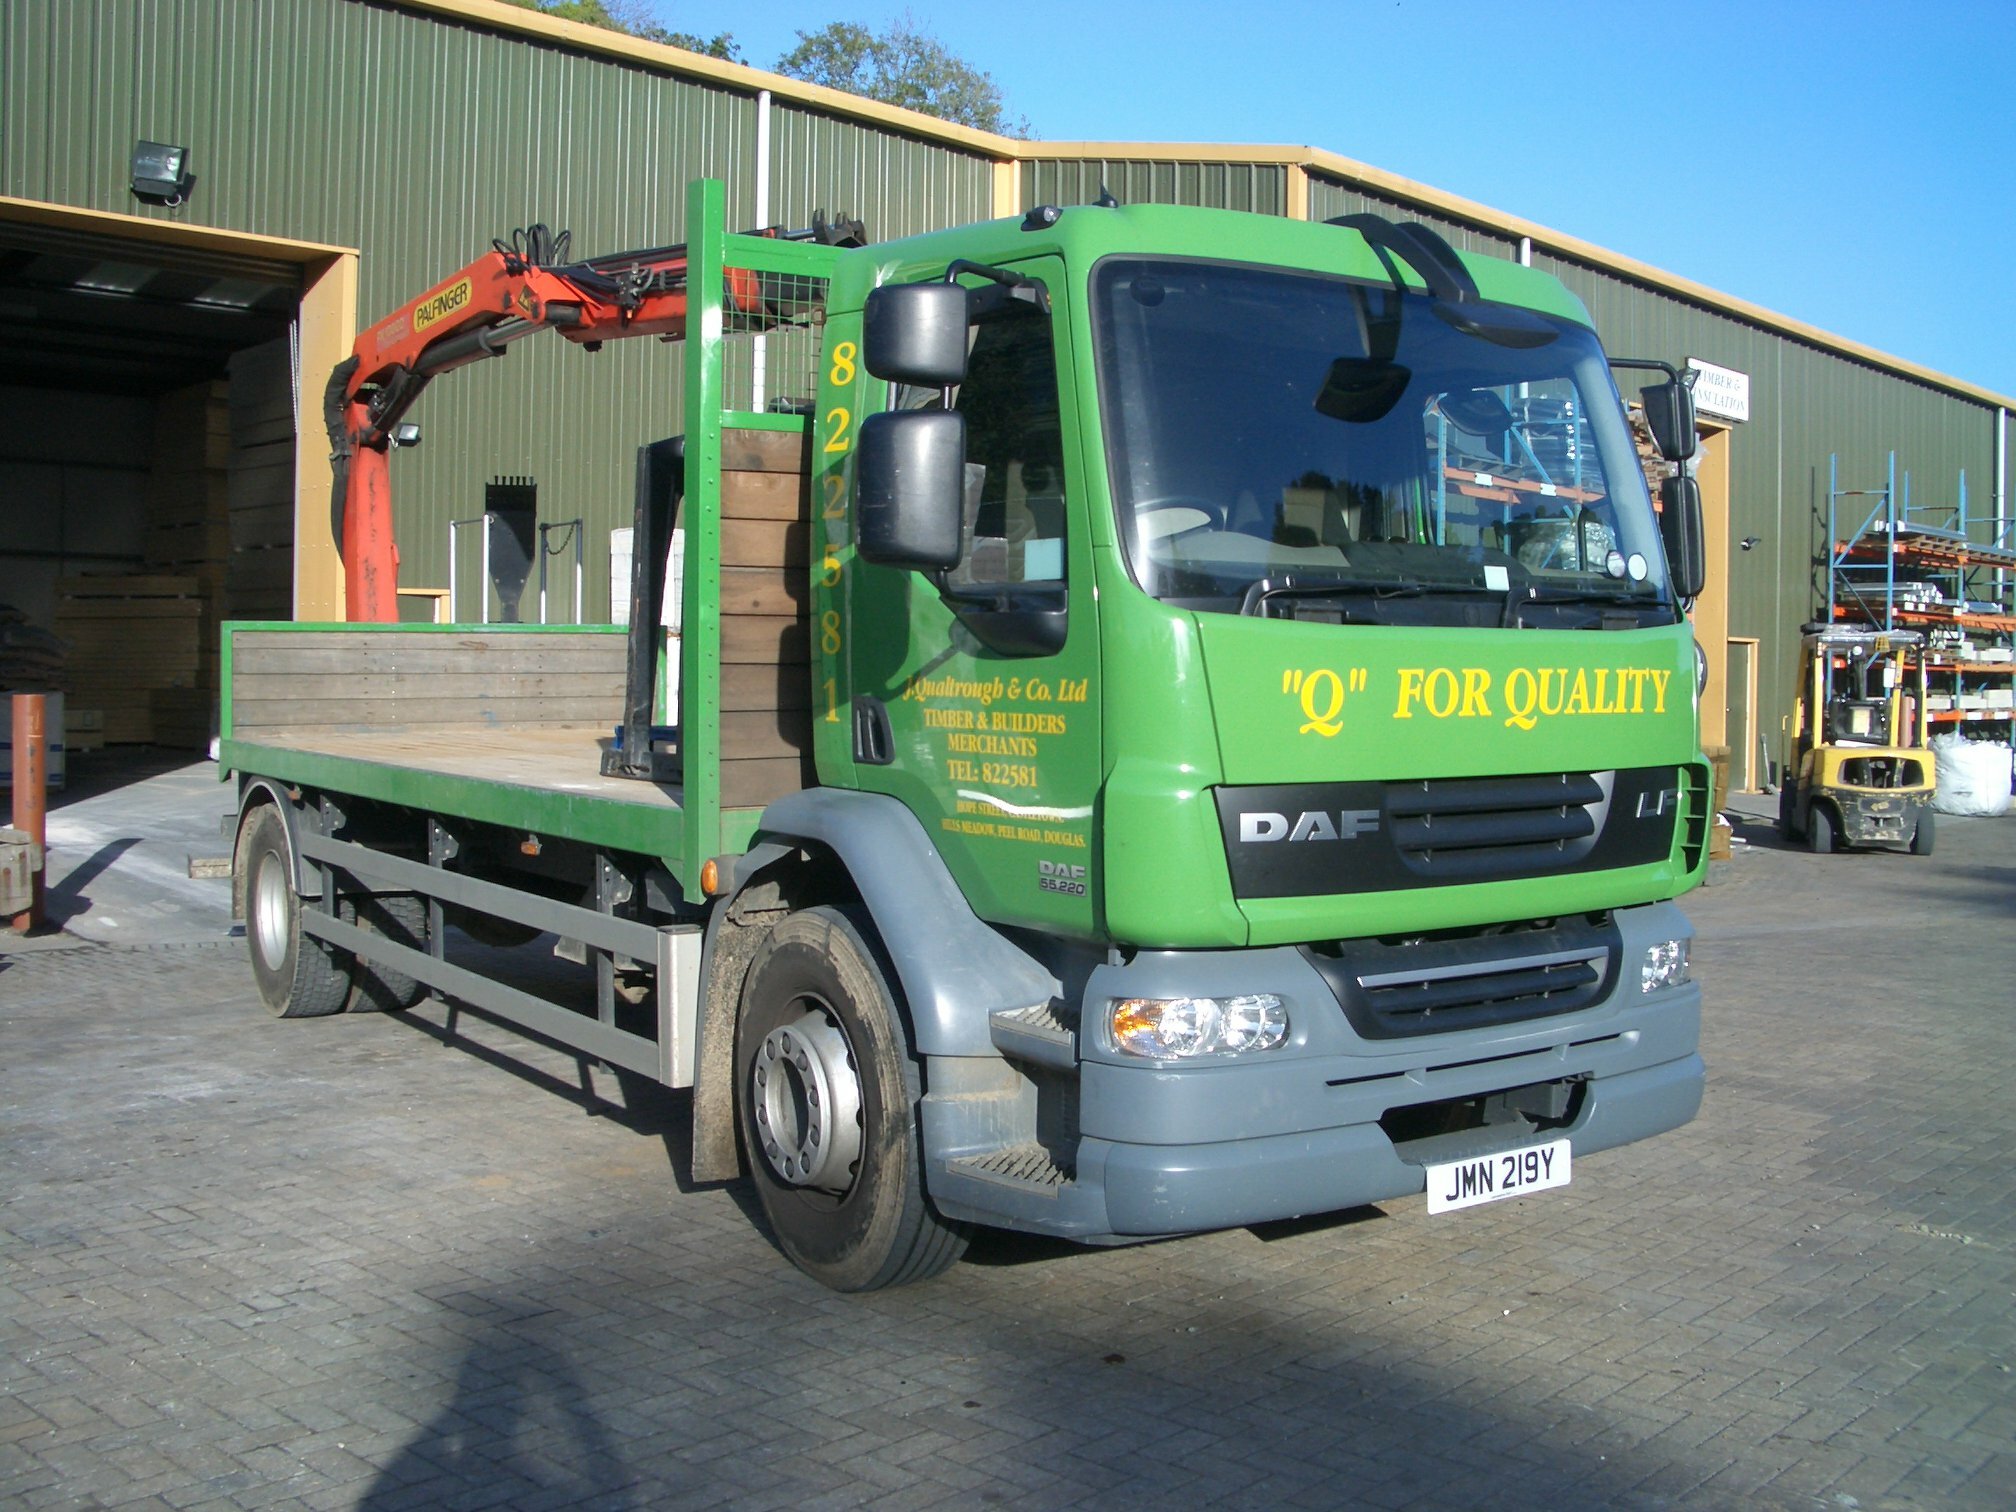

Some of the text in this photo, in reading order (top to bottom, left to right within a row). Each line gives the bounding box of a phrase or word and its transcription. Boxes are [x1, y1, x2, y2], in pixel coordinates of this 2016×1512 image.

[417, 282, 468, 327] PALFINGER
[1007, 677, 1022, 700] &
[1026, 678, 1052, 701] Co.
[1057, 678, 1089, 703] Ltd
[1282, 666, 1672, 737] "Q" FOR QUALITY
[924, 708, 1067, 734] TIMBER & BUILDERS
[948, 733, 1037, 757] MERCHANTS
[947, 759, 1037, 788] TEL: 822581
[1636, 788, 1677, 818] LF
[998, 825, 1017, 839] PEEL
[1239, 809, 1380, 842] DAF
[1039, 860, 1086, 879] DAF
[1445, 1147, 1555, 1202] JMN 219Y
